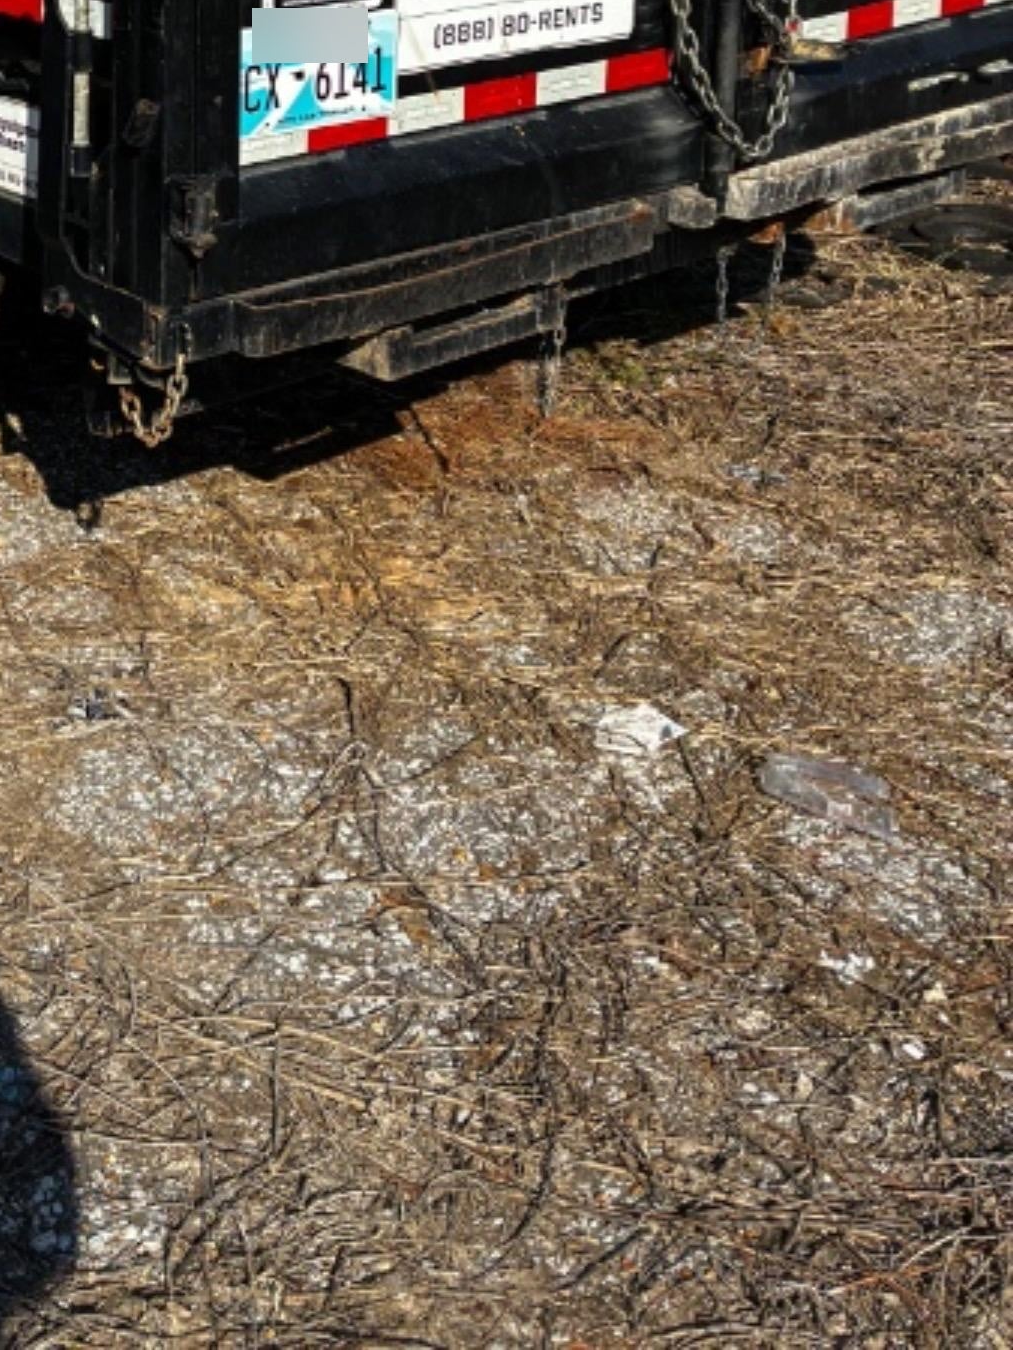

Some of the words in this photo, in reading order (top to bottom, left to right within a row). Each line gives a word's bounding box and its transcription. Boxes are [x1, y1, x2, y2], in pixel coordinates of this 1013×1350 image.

[434, 18, 493, 48] (888)
[501, 2, 604, 37] 80-RENTS
[316, 47, 387, 100] 6141
